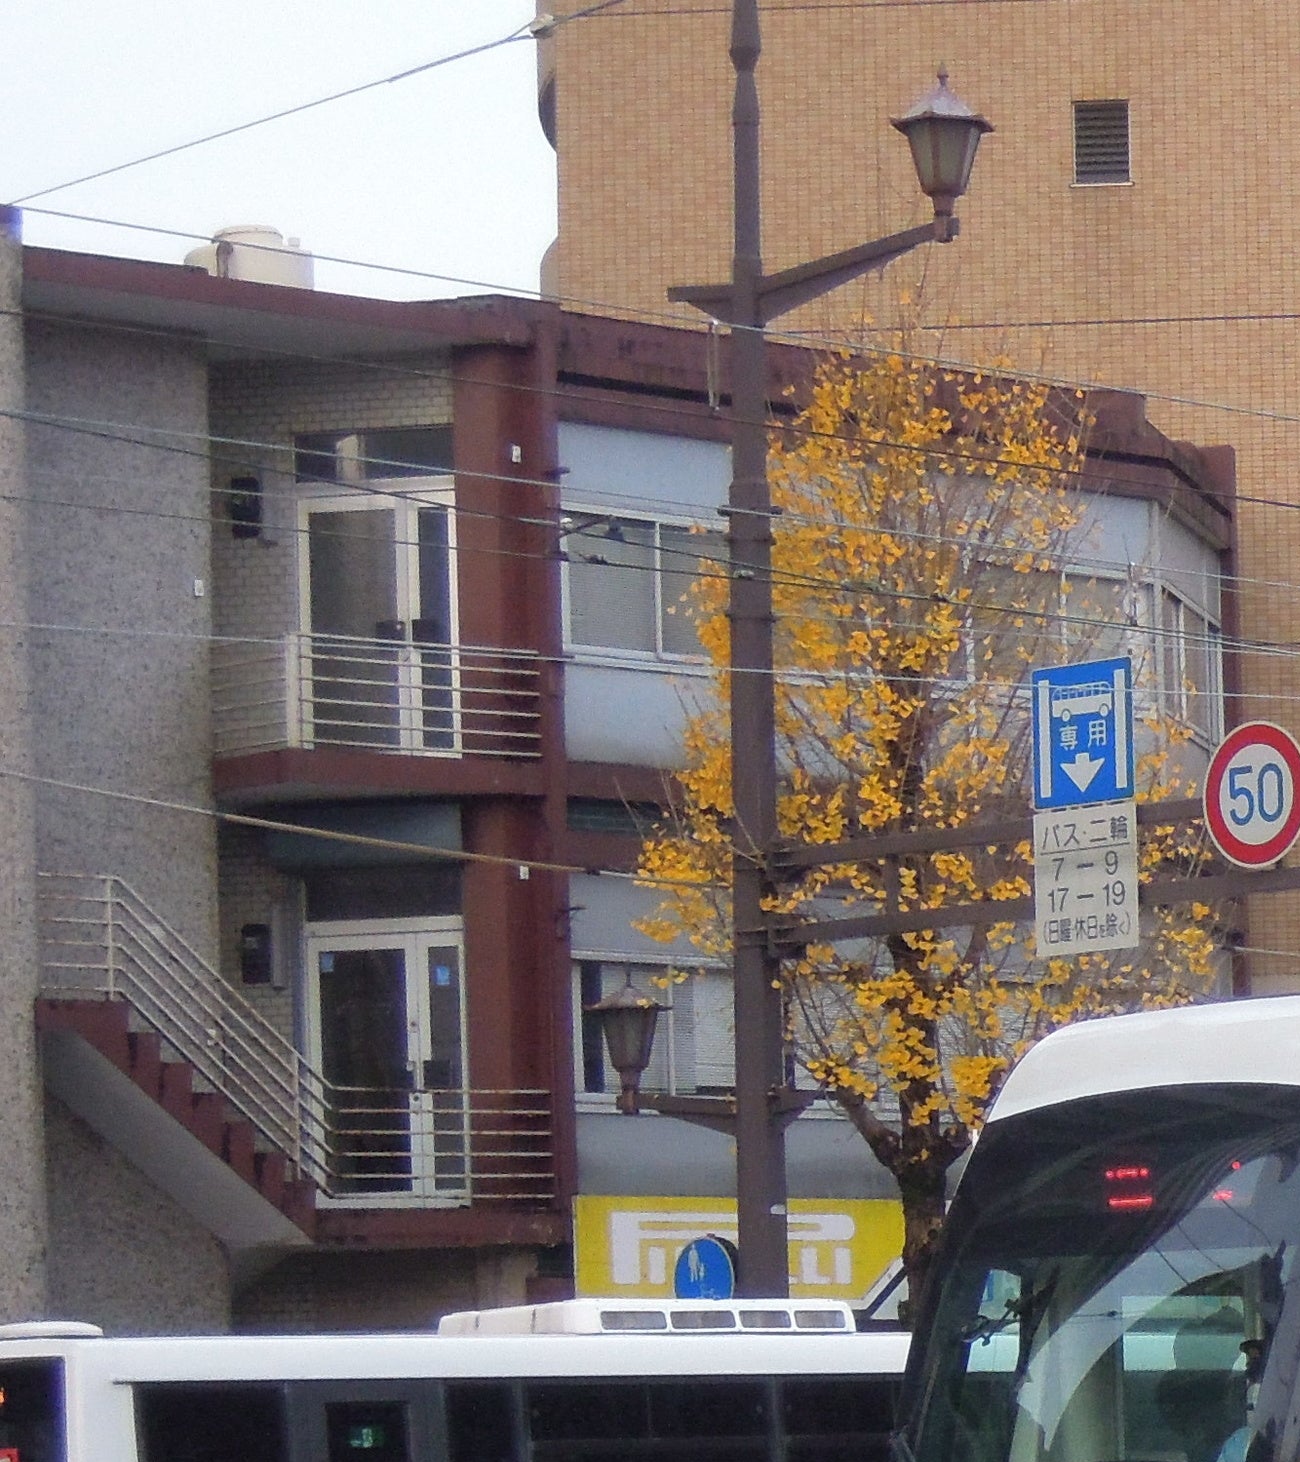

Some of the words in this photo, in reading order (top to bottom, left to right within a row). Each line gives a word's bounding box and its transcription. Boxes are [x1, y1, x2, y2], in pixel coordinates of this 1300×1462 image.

[1059, 719, 1108, 752] 専用
[1228, 763, 1285, 827] 50
[611, 1211, 854, 1286] PILI
